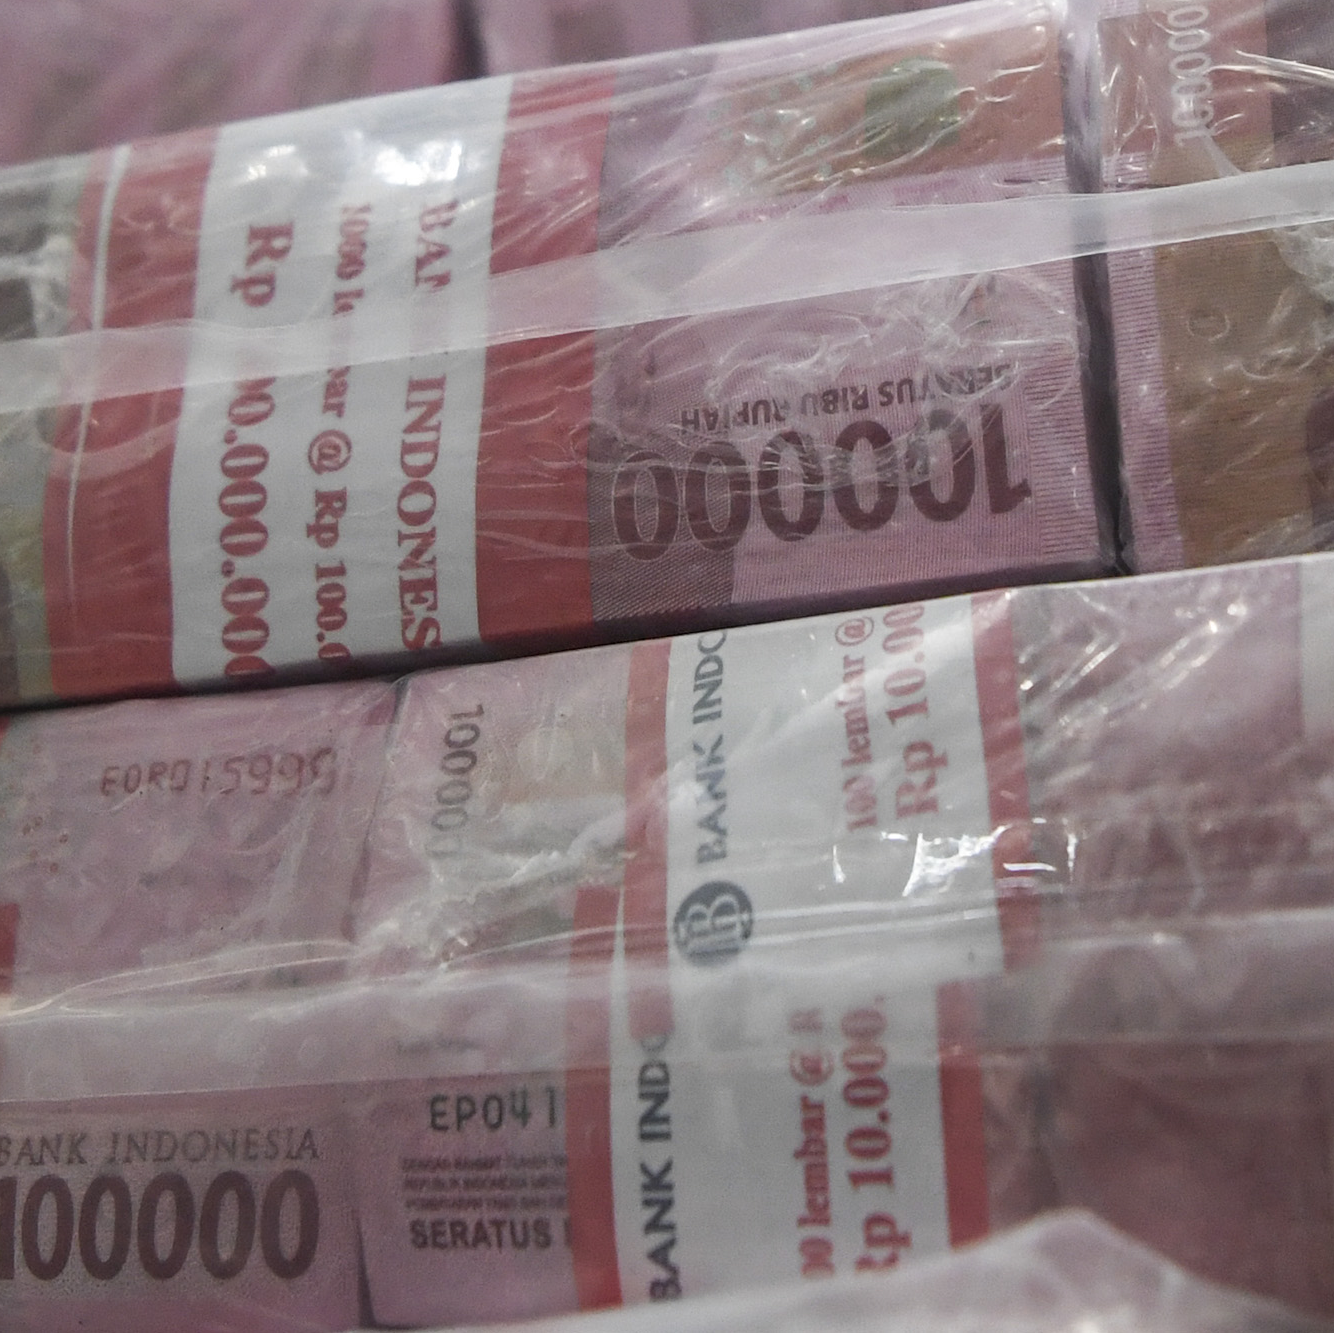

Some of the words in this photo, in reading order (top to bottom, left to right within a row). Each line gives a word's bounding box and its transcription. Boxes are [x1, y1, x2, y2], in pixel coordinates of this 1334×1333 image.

[227, 221, 295, 311] Rp
[800, 385, 869, 418] RIBU
[308, 429, 354, 475] @
[610, 402, 1033, 562] 100000
[307, 489, 349, 551] Rp
[834, 616, 875, 648] @
[691, 733, 729, 866] BANK
[841, 775, 878, 833] 100
[893, 740, 949, 822] Rp
[109, 1125, 320, 1165] INDONESIA
[791, 1094, 831, 1229] lembar
[409, 1218, 553, 1252] SERATUS
[639, 1158, 681, 1303] BANK
